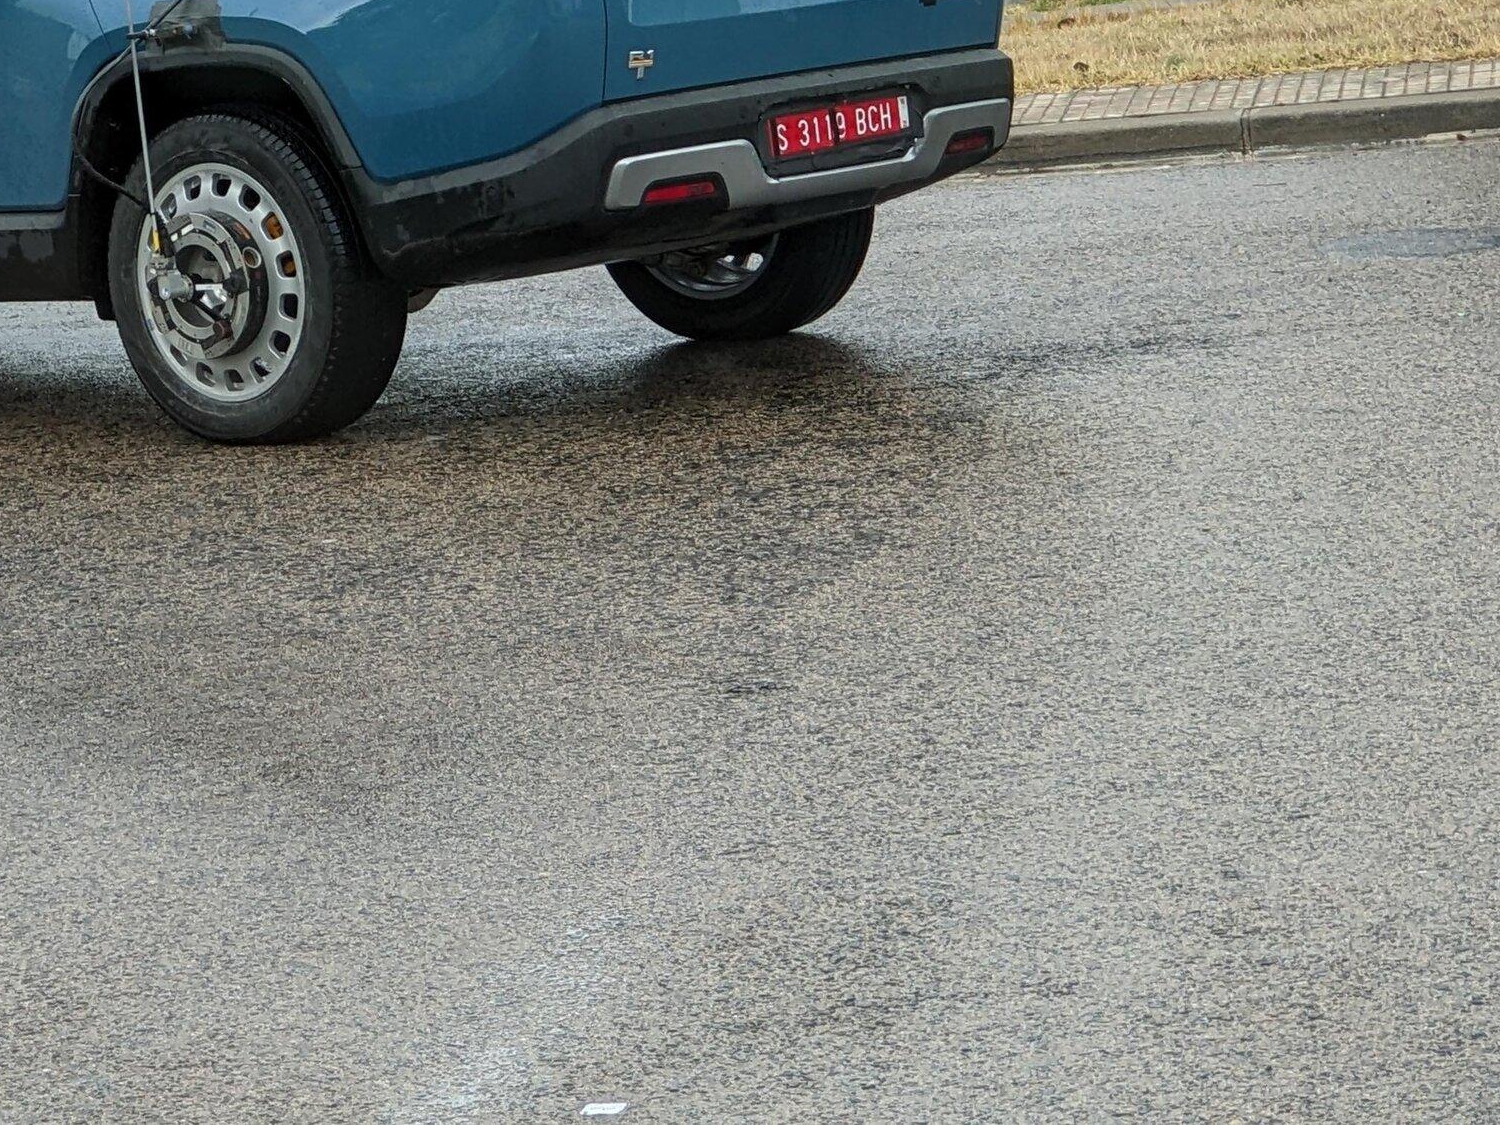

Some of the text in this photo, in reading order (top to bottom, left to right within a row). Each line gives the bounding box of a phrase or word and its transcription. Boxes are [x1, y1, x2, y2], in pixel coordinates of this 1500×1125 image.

[776, 123, 788, 152] S
[798, 111, 846, 148] 3119
[855, 101, 892, 136] BCH
